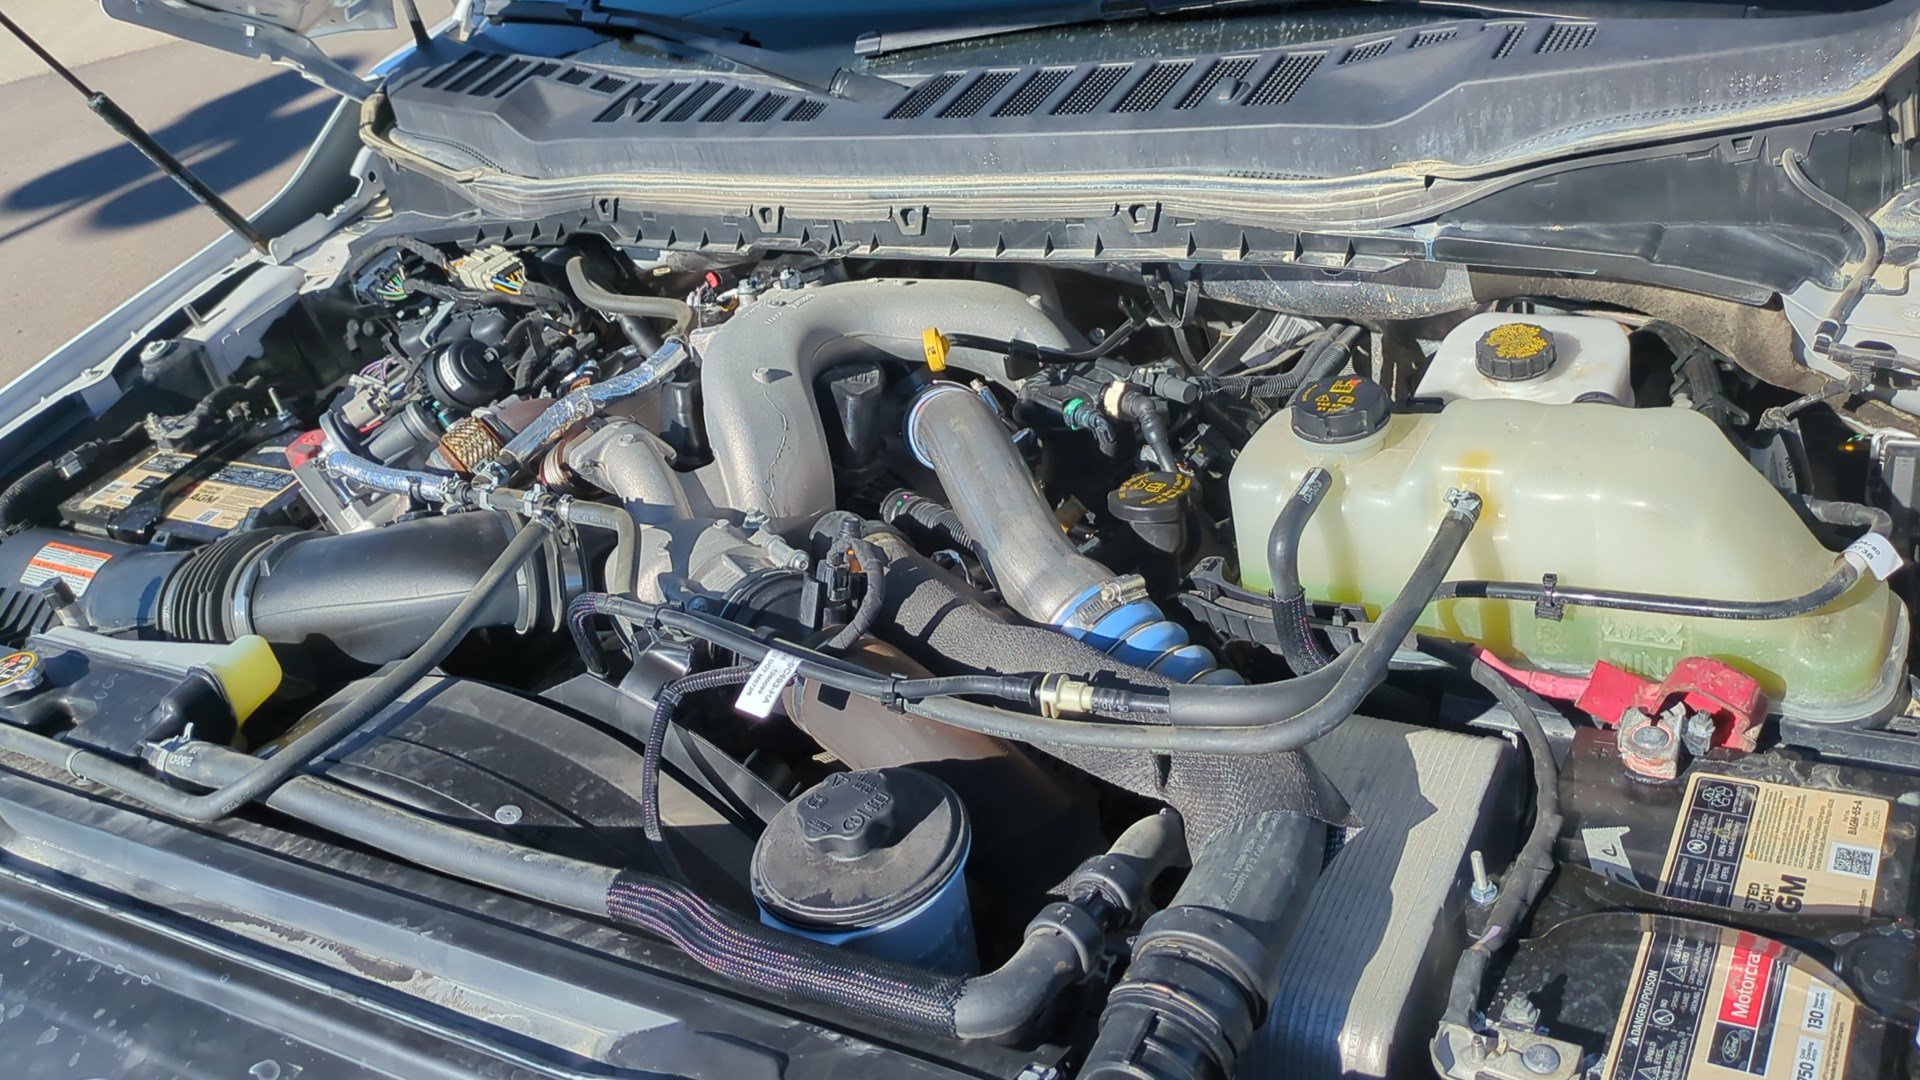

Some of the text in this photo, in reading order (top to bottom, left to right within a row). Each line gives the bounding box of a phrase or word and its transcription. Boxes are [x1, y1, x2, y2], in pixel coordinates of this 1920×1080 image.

[1742, 881, 1761, 912] STED
[1757, 886, 1774, 914] UGH
[1631, 970, 1659, 1036] DANGER/POISON
[1806, 1009, 1825, 1030] 130
[1723, 1034, 1740, 1058] Ford
